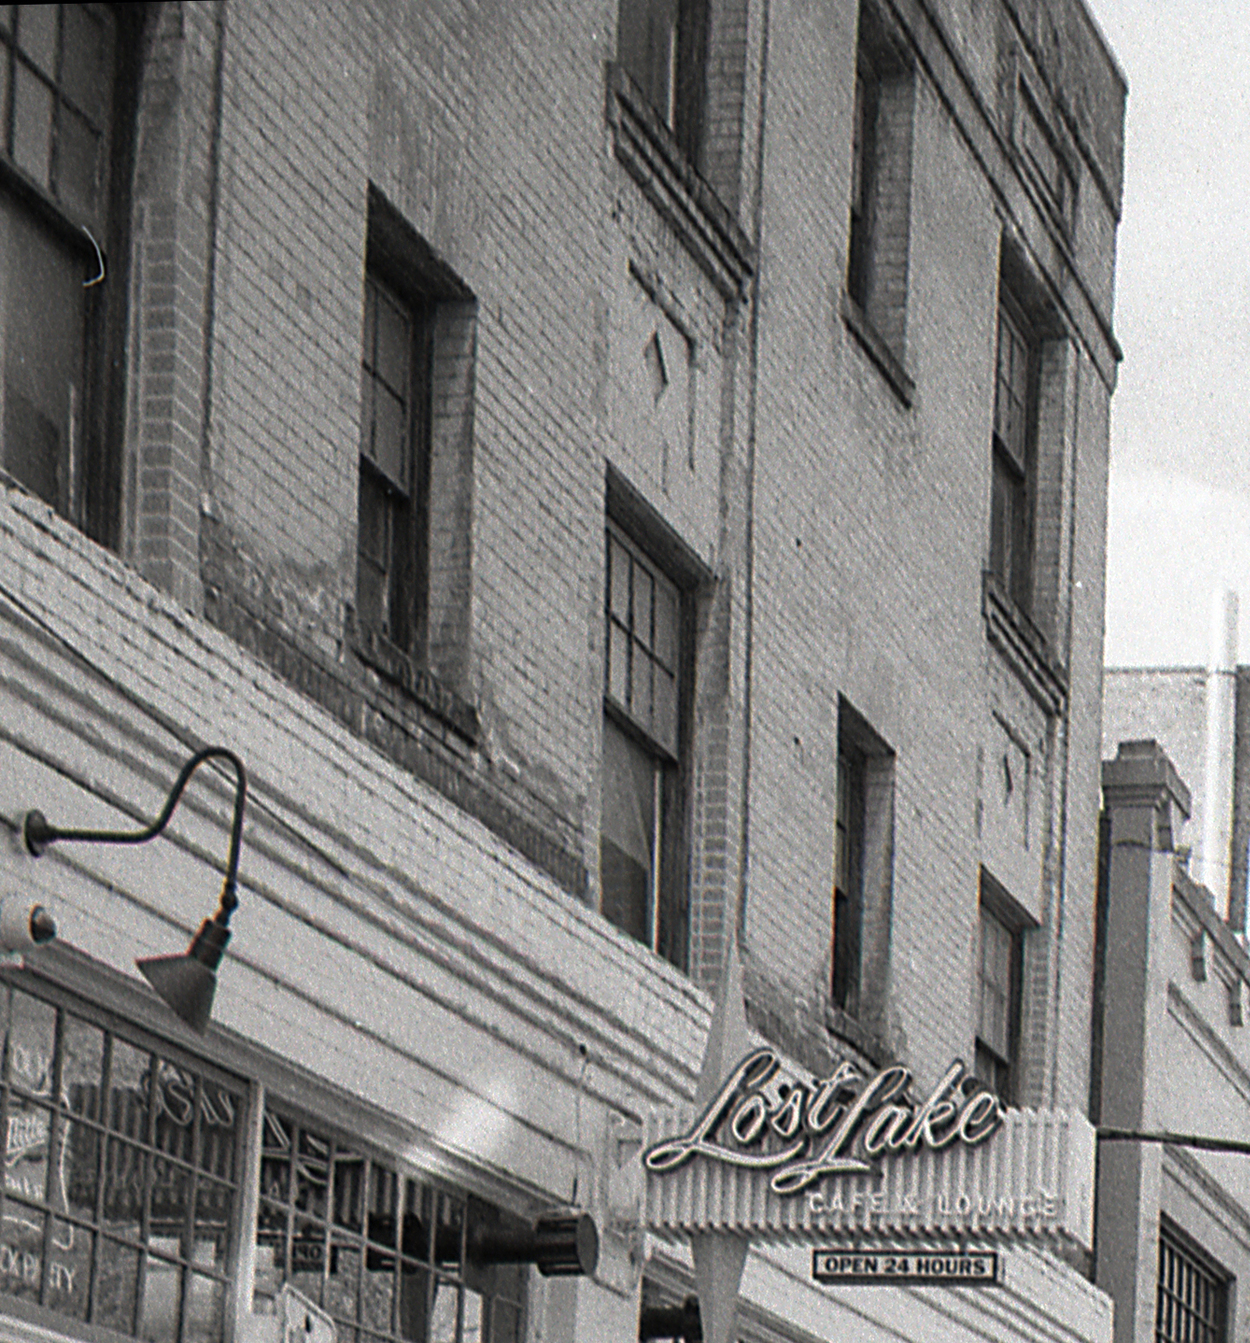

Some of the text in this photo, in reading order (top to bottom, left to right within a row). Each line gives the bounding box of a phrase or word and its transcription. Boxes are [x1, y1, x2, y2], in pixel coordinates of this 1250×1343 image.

[644, 1048, 1007, 1194] Lost Lake
[807, 1192, 889, 1214] CAFE
[936, 1193, 1058, 1217] LOUNGE
[824, 1258, 987, 1275] OPEN 24 HOURS
